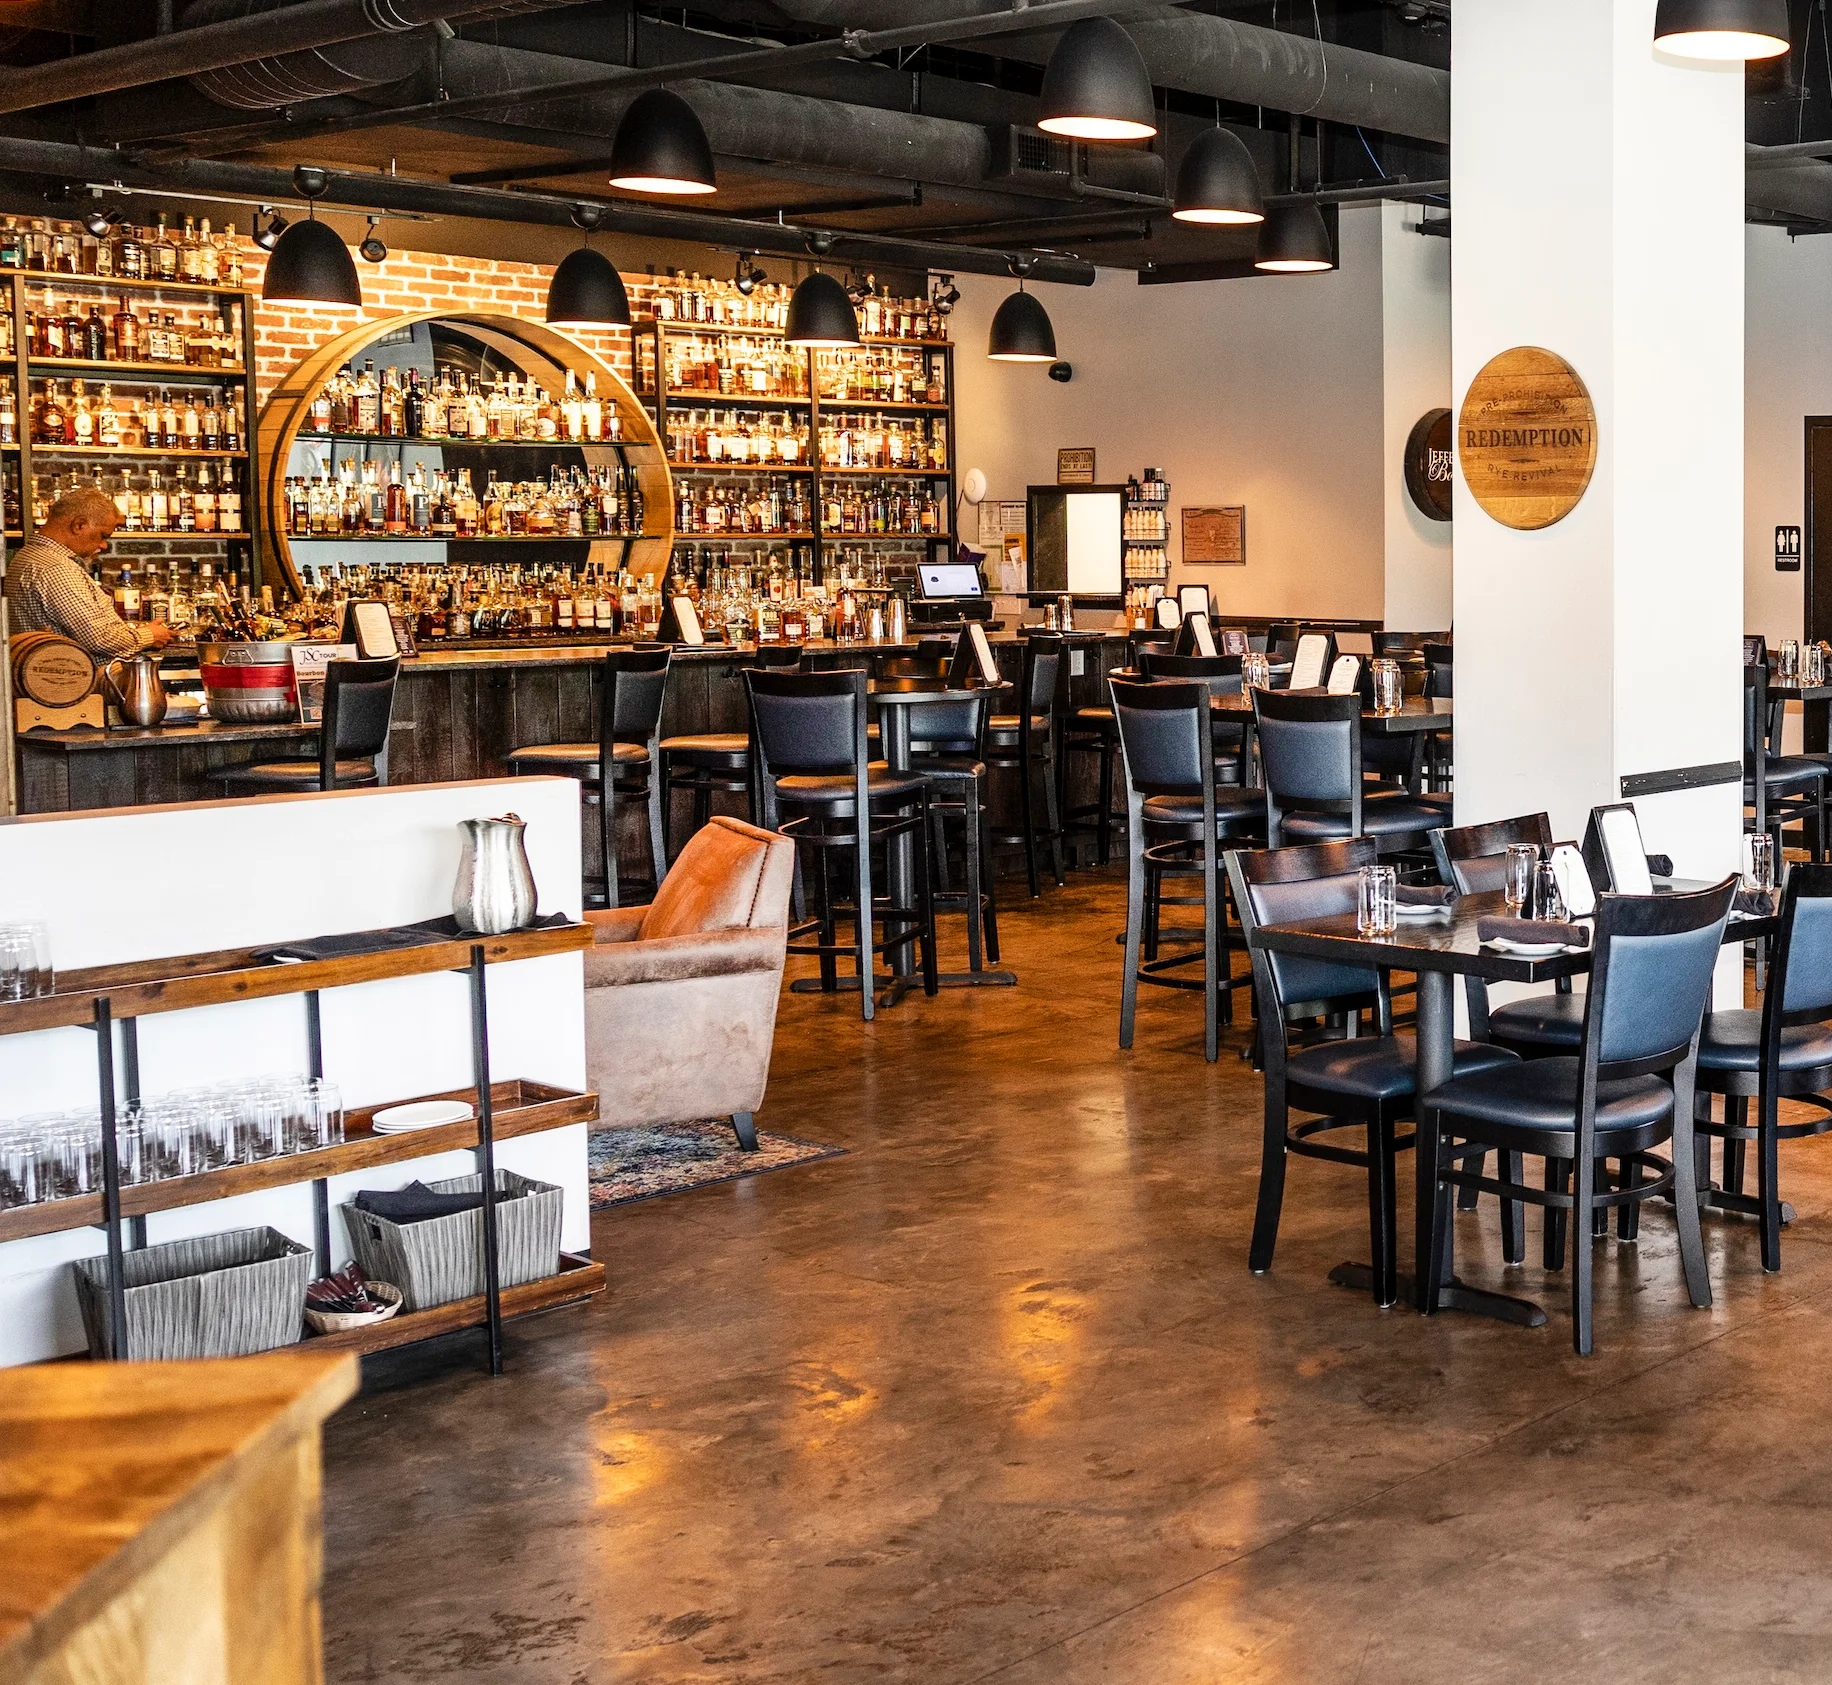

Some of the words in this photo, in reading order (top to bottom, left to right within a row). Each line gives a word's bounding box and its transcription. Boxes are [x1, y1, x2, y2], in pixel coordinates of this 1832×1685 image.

[1465, 427, 1585, 449] REDEMPTION
[1060, 451, 1093, 463] PROHIBITION
[1487, 463, 1509, 479] RYE
[1513, 464, 1562, 481] REVIVAL
[418, 496, 429, 509] P
